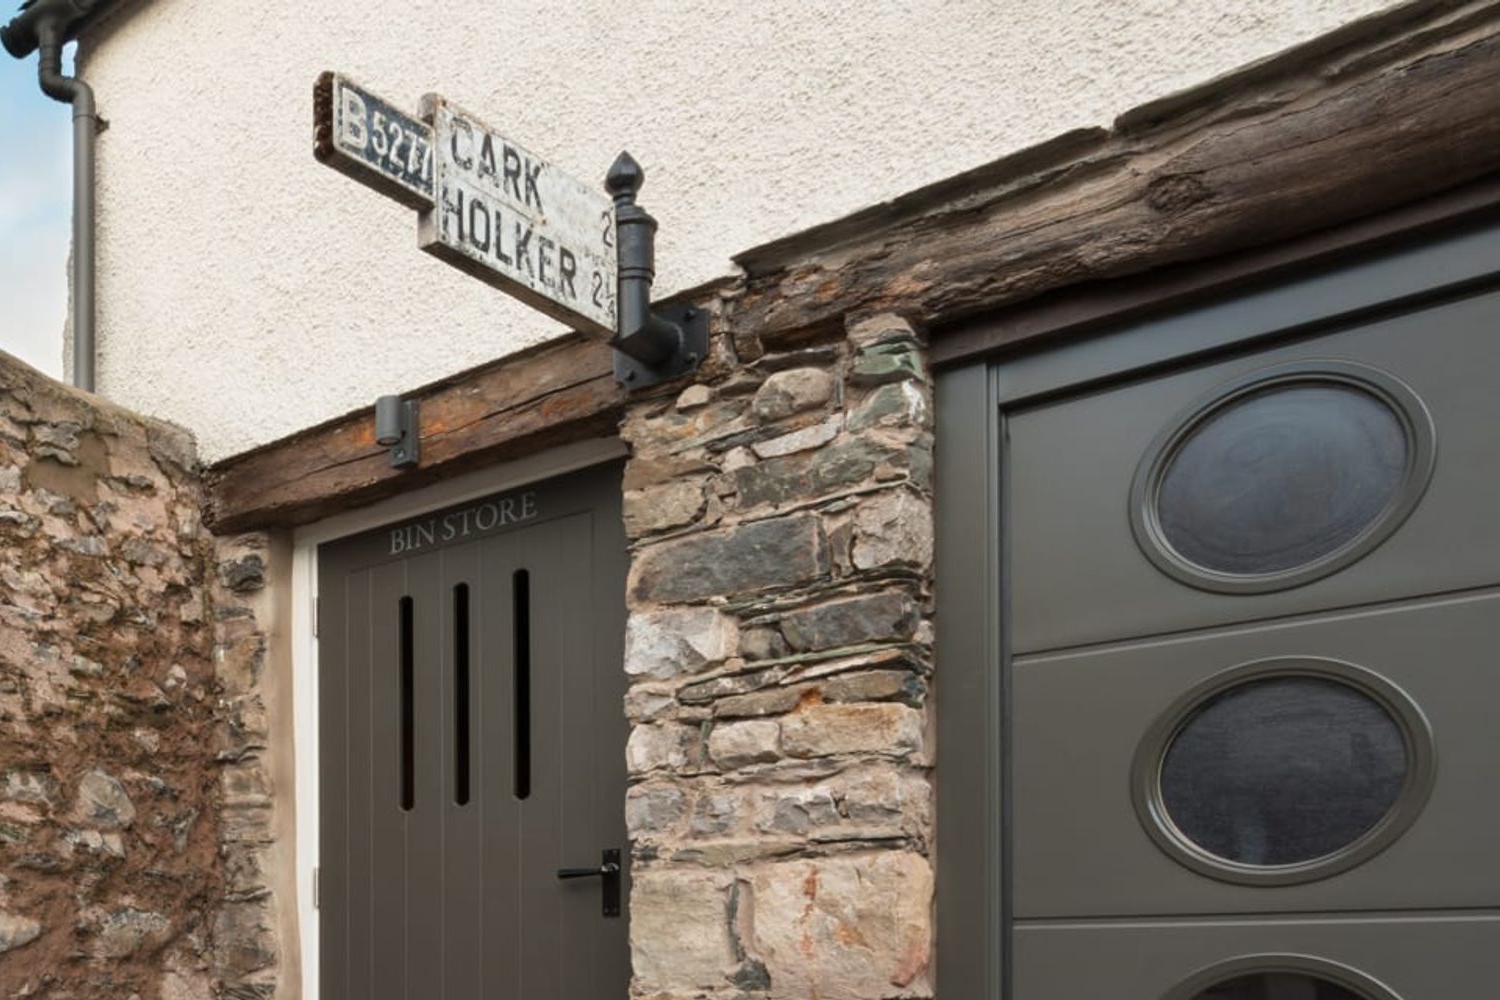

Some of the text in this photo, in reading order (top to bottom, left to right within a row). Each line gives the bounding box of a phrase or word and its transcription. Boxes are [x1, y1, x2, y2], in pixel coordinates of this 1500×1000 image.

[451, 117, 544, 217] CARK
[442, 187, 578, 300] HOLKER
[389, 492, 538, 554] BIN STORE
